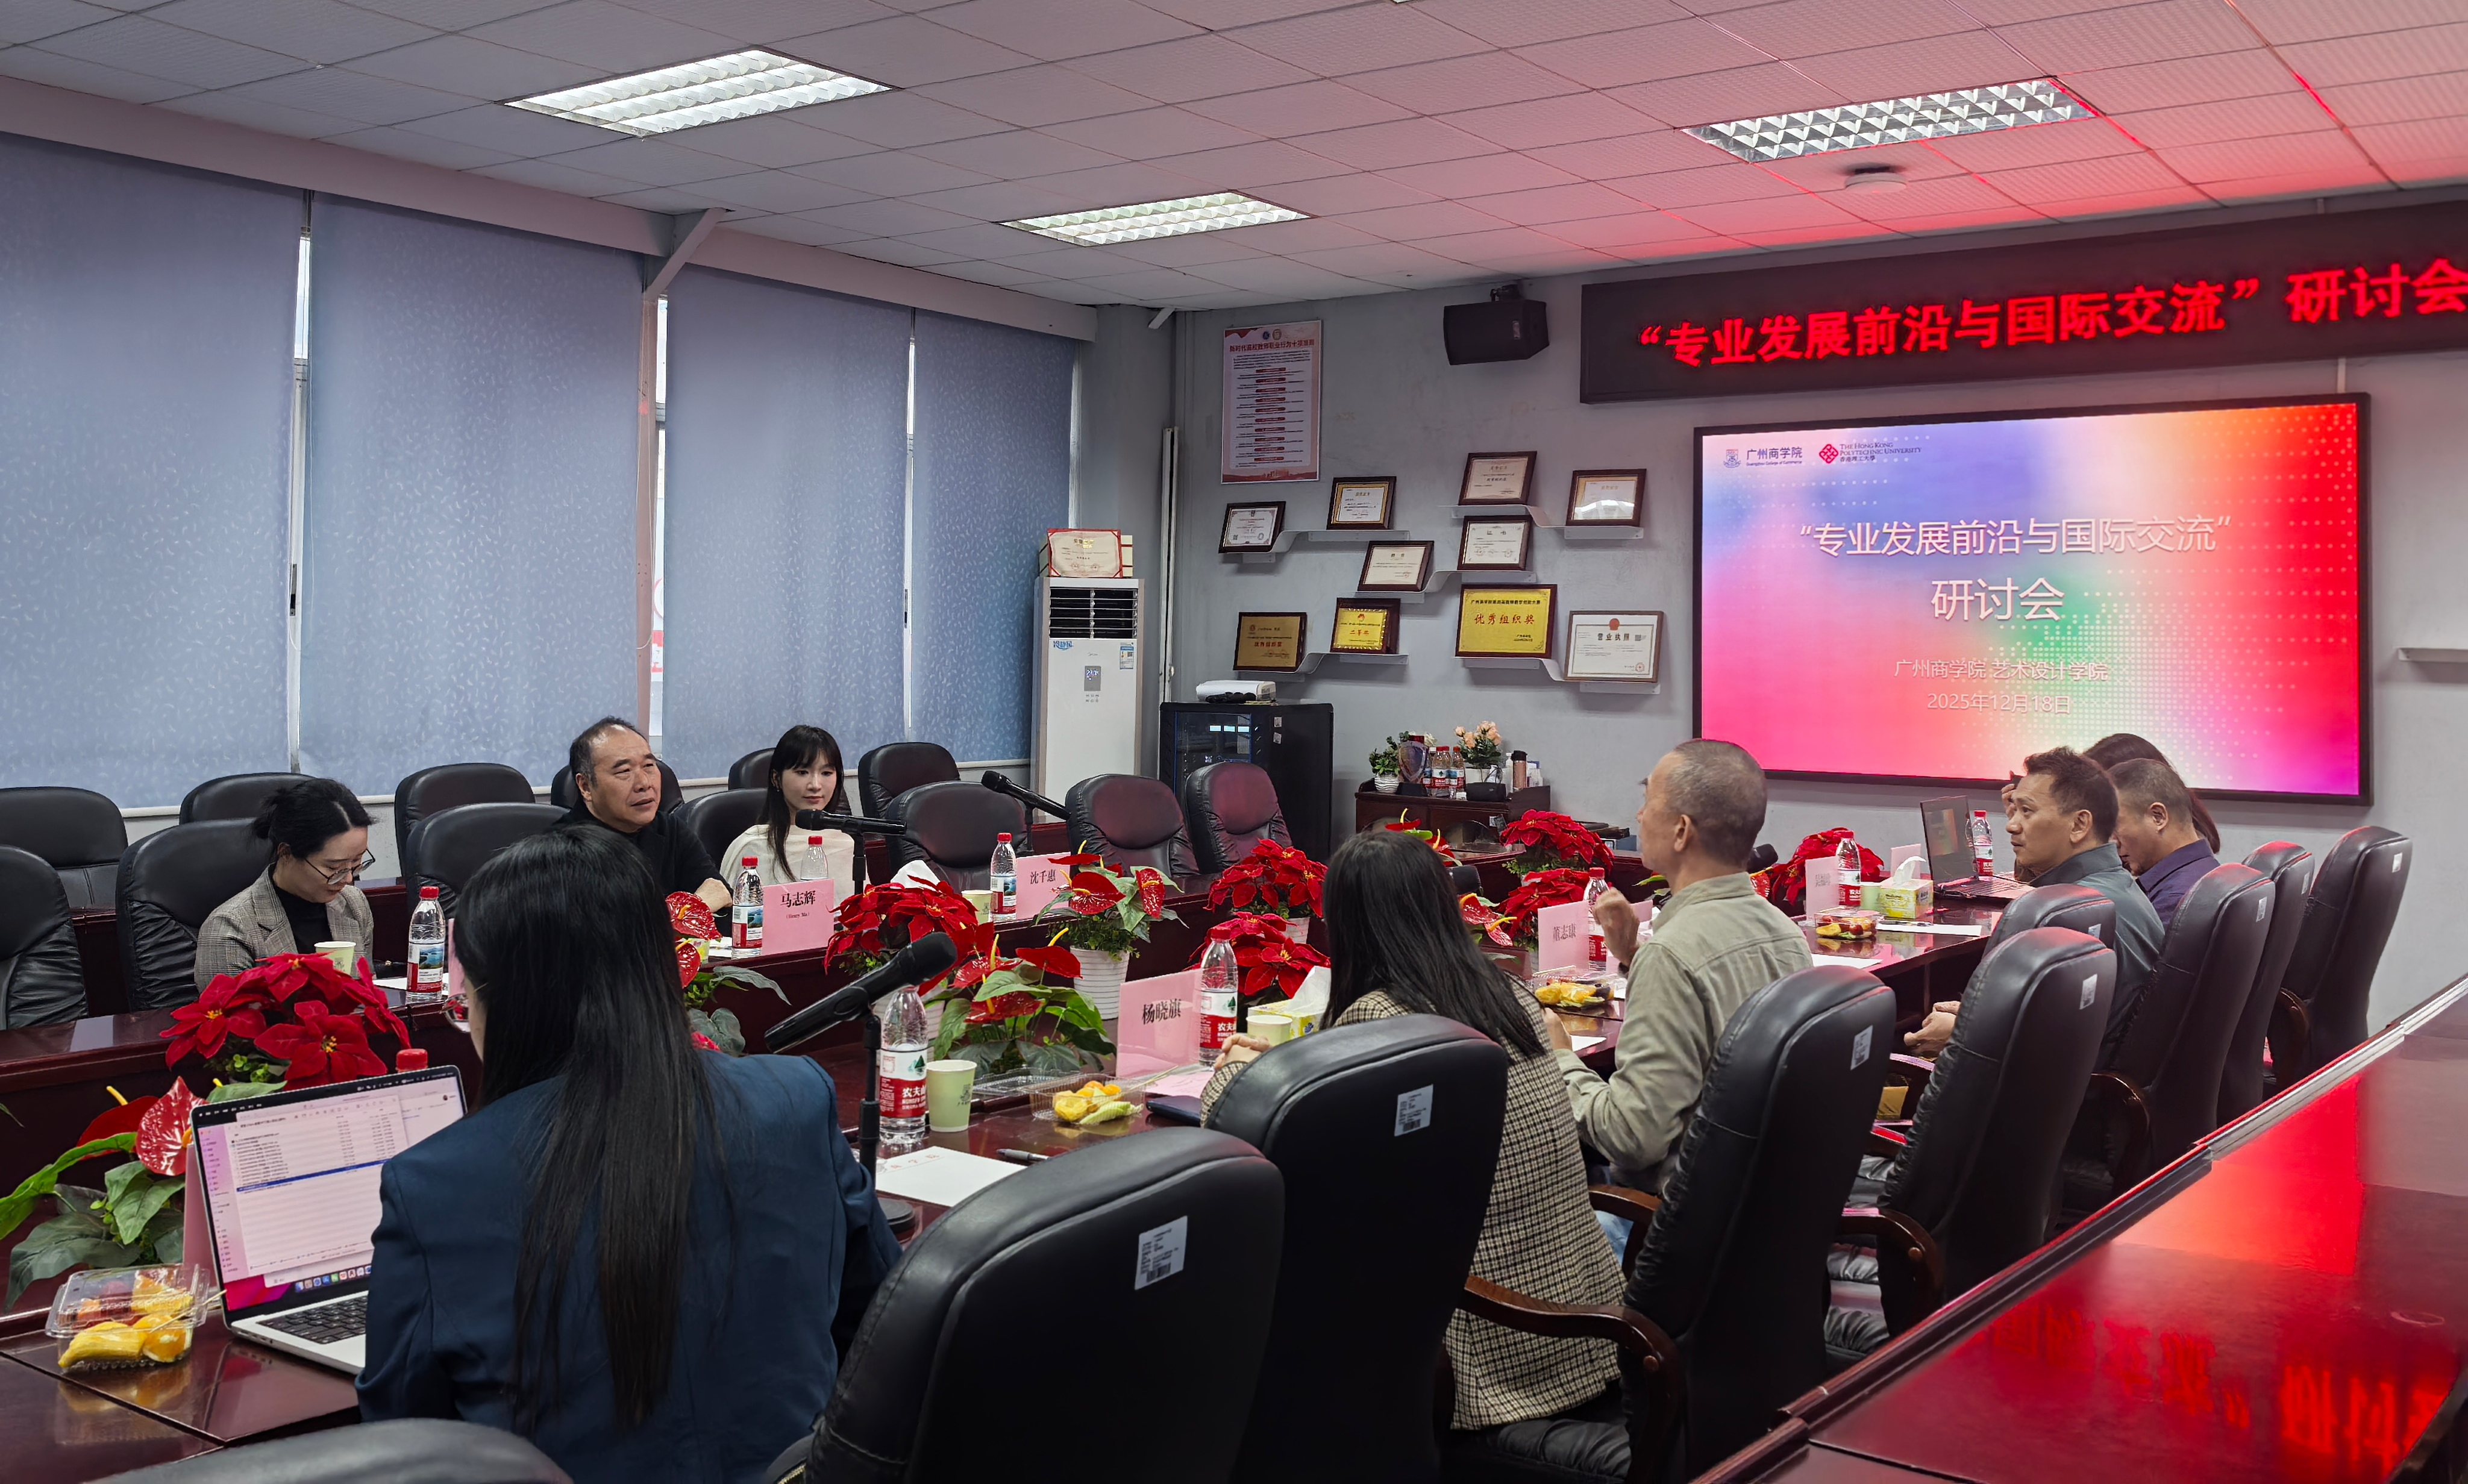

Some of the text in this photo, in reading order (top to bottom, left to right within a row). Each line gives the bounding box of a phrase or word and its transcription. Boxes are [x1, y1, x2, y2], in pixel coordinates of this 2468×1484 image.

[1641, 258, 2468, 367] “专业发展前沿与国际交流” 研讨会
[1747, 446, 1802, 460] 广州商学院
[1800, 515, 2231, 557] “专业发展前沿与国际交流”
[1931, 577, 2066, 622] 研讨会
[1474, 613, 1535, 625] 优秀组织奖
[1894, 659, 2109, 681] 广州商学院 艺术设计学院
[1928, 693, 2071, 715] 2025年12月18日
[1030, 869, 1056, 884] 沈千惠
[780, 890, 815, 907] 马志辉
[1142, 998, 1182, 1025] 杨晓旗
